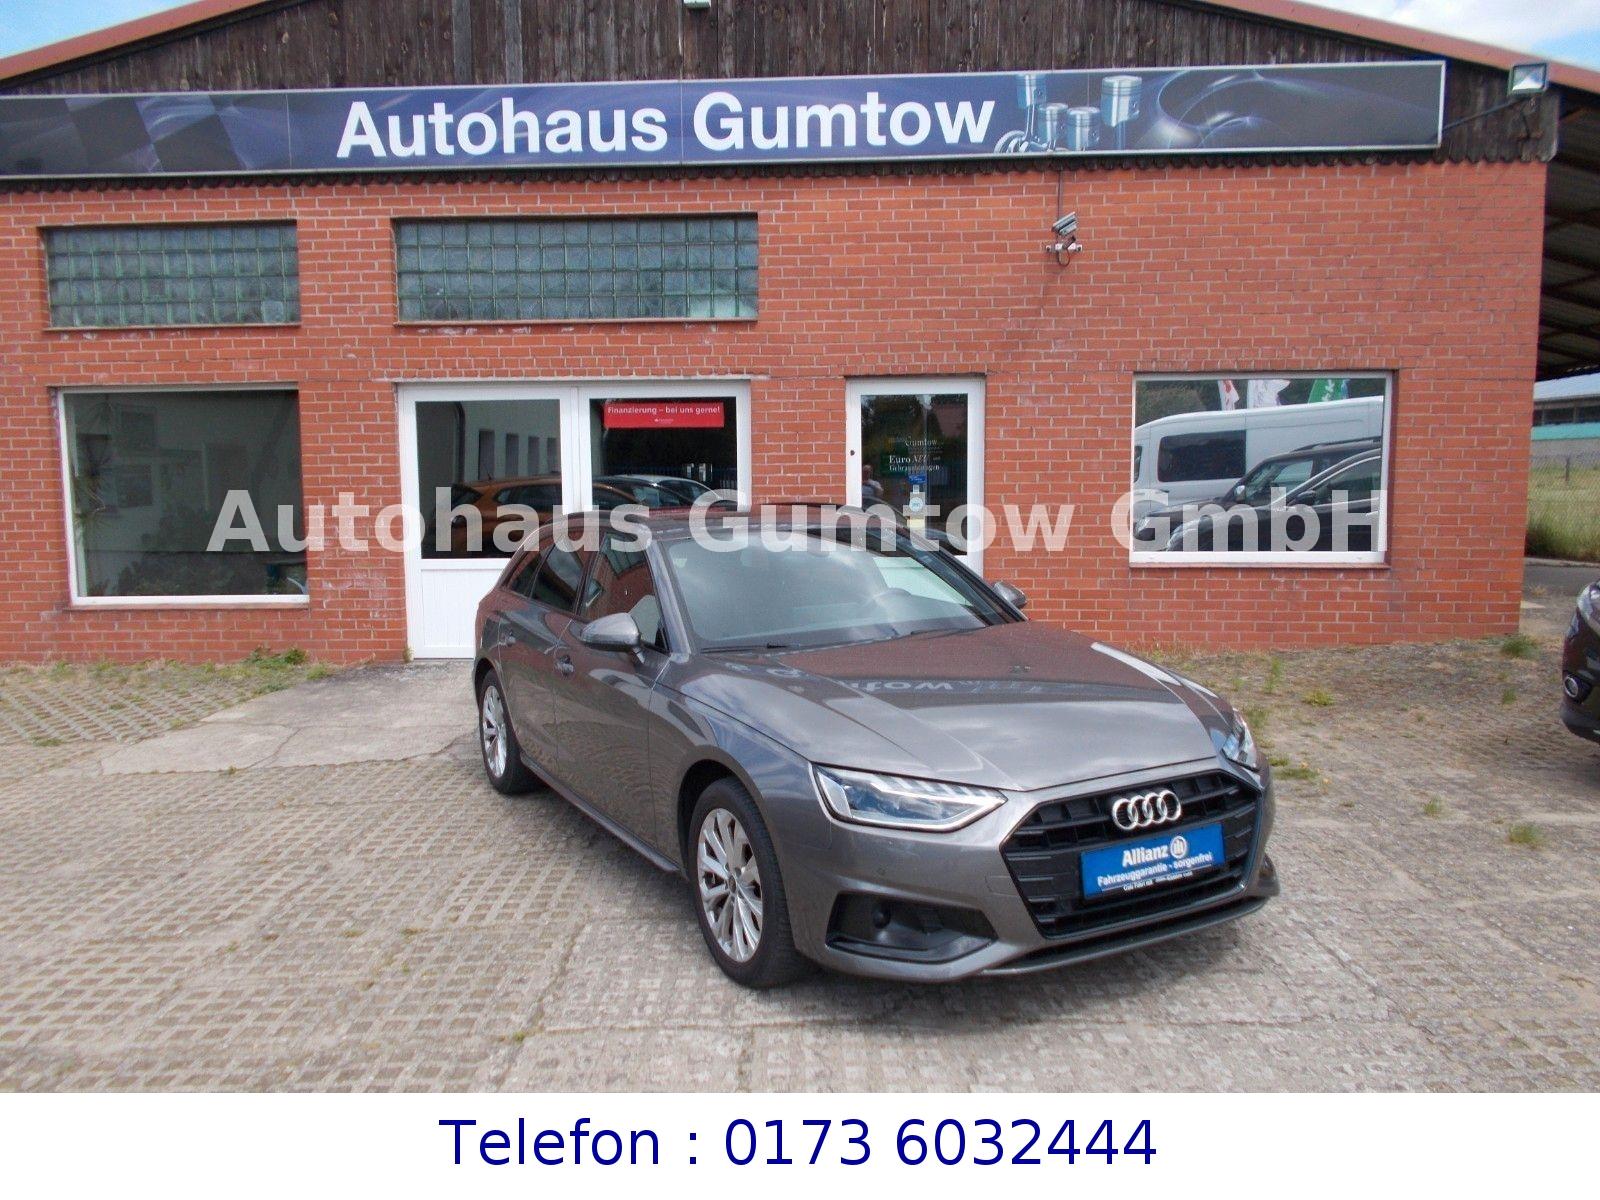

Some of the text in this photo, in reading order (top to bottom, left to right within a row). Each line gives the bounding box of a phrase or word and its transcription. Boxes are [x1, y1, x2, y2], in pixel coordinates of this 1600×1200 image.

[336, 91, 995, 158] Autohaus Gumtow
[607, 406, 657, 415] Finanzierung
[665, 406, 678, 414] bei
[889, 455, 911, 464] Euro
[1122, 845, 1169, 867] Allianz
[1097, 862, 1168, 887] Fahrzeuggarantie
[1174, 852, 1213, 870] sorgenfrei
